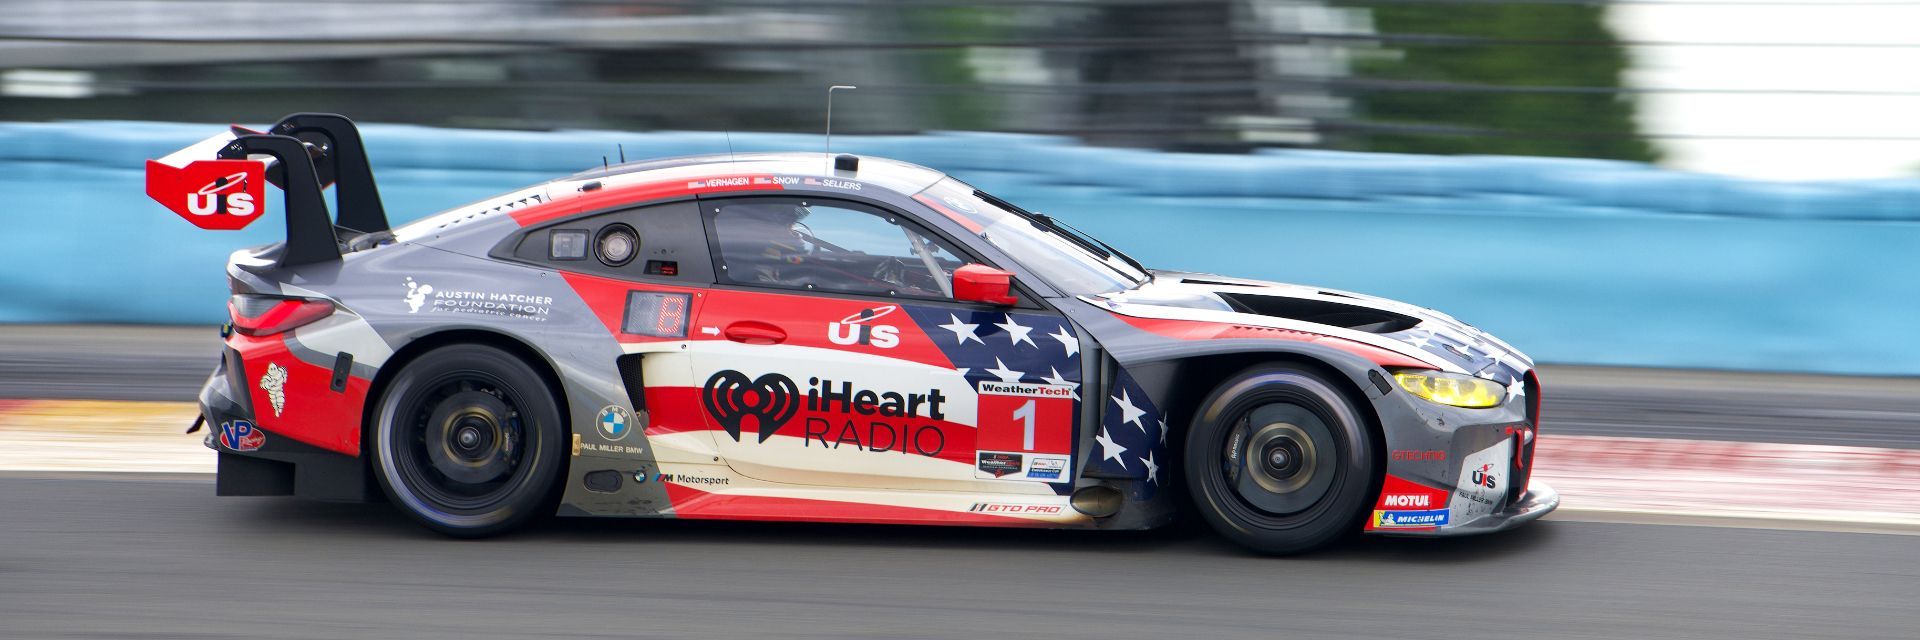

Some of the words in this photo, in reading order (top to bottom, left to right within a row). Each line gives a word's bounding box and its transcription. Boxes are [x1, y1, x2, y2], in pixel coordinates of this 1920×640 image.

[705, 178, 749, 187] VERHAGEN
[772, 177, 799, 185] SNOW
[822, 179, 862, 190] SELLERS
[435, 291, 485, 300] AUSTIN
[490, 292, 553, 305] HATCHER
[433, 299, 549, 315] FOUNDATION
[452, 307, 506, 316] pediatric
[509, 312, 547, 322] cancer
[982, 384, 1071, 396] WeatherTech
[807, 376, 946, 421] iHeart
[601, 406, 628, 417] BMW
[1013, 400, 1036, 451] 1
[221, 420, 253, 450] VP
[805, 417, 945, 457] RADIO
[580, 442, 597, 451] PAUL
[598, 444, 624, 453] MILLER
[625, 446, 643, 454] BMW
[677, 474, 729, 485] Motorsport
[1384, 495, 1430, 507] MOTUL
[987, 504, 1023, 512] GTD
[1025, 505, 1061, 513] PRO
[1397, 514, 1445, 523] MICHELIN
